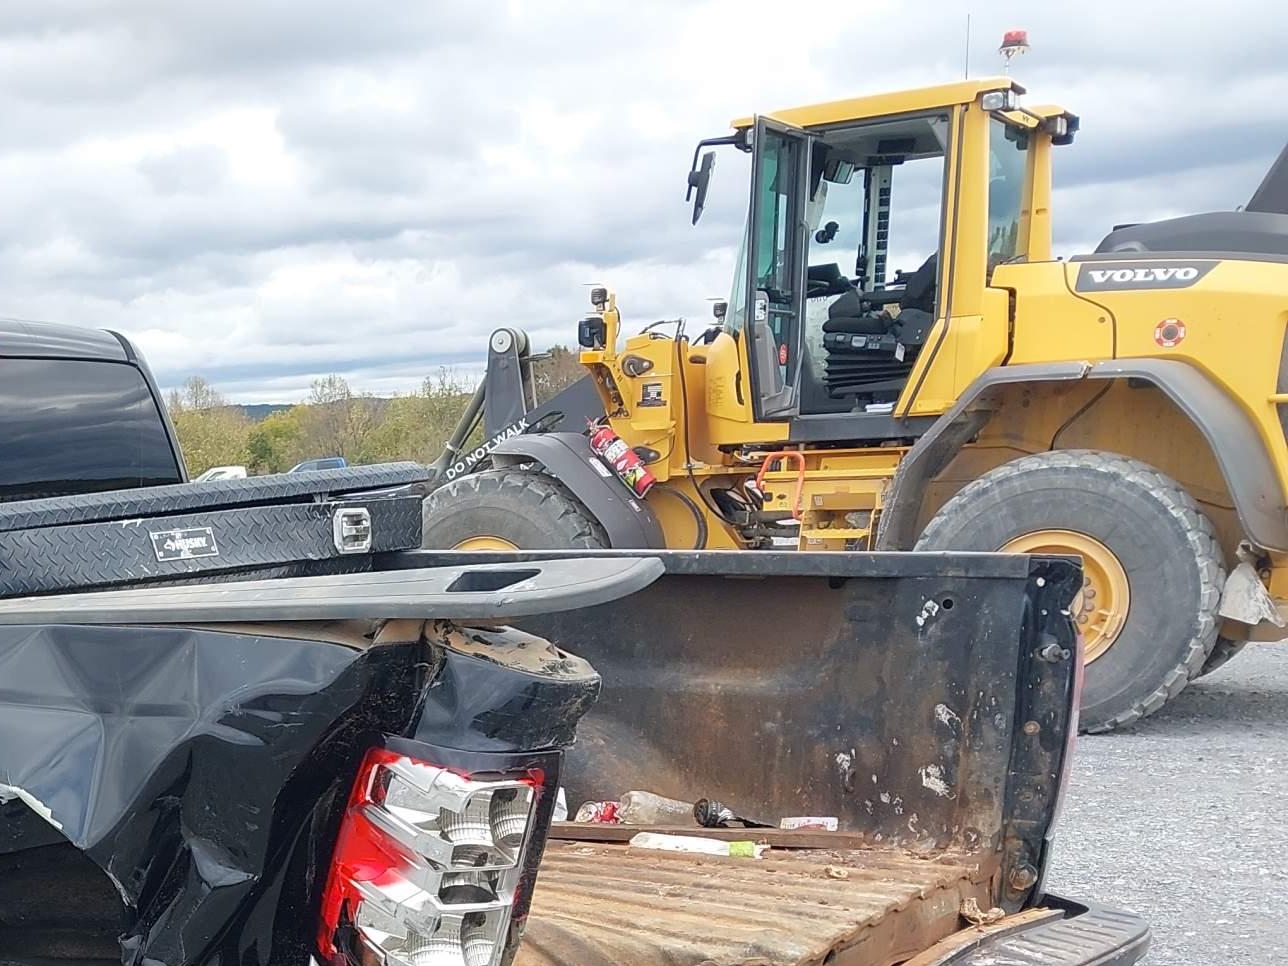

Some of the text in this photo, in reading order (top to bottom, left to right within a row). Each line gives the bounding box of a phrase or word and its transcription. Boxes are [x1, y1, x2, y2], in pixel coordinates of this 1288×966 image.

[1088, 267, 1199, 283] VOLVO
[445, 417, 530, 480] DO NOT WALK
[174, 536, 208, 550] HUSKY
